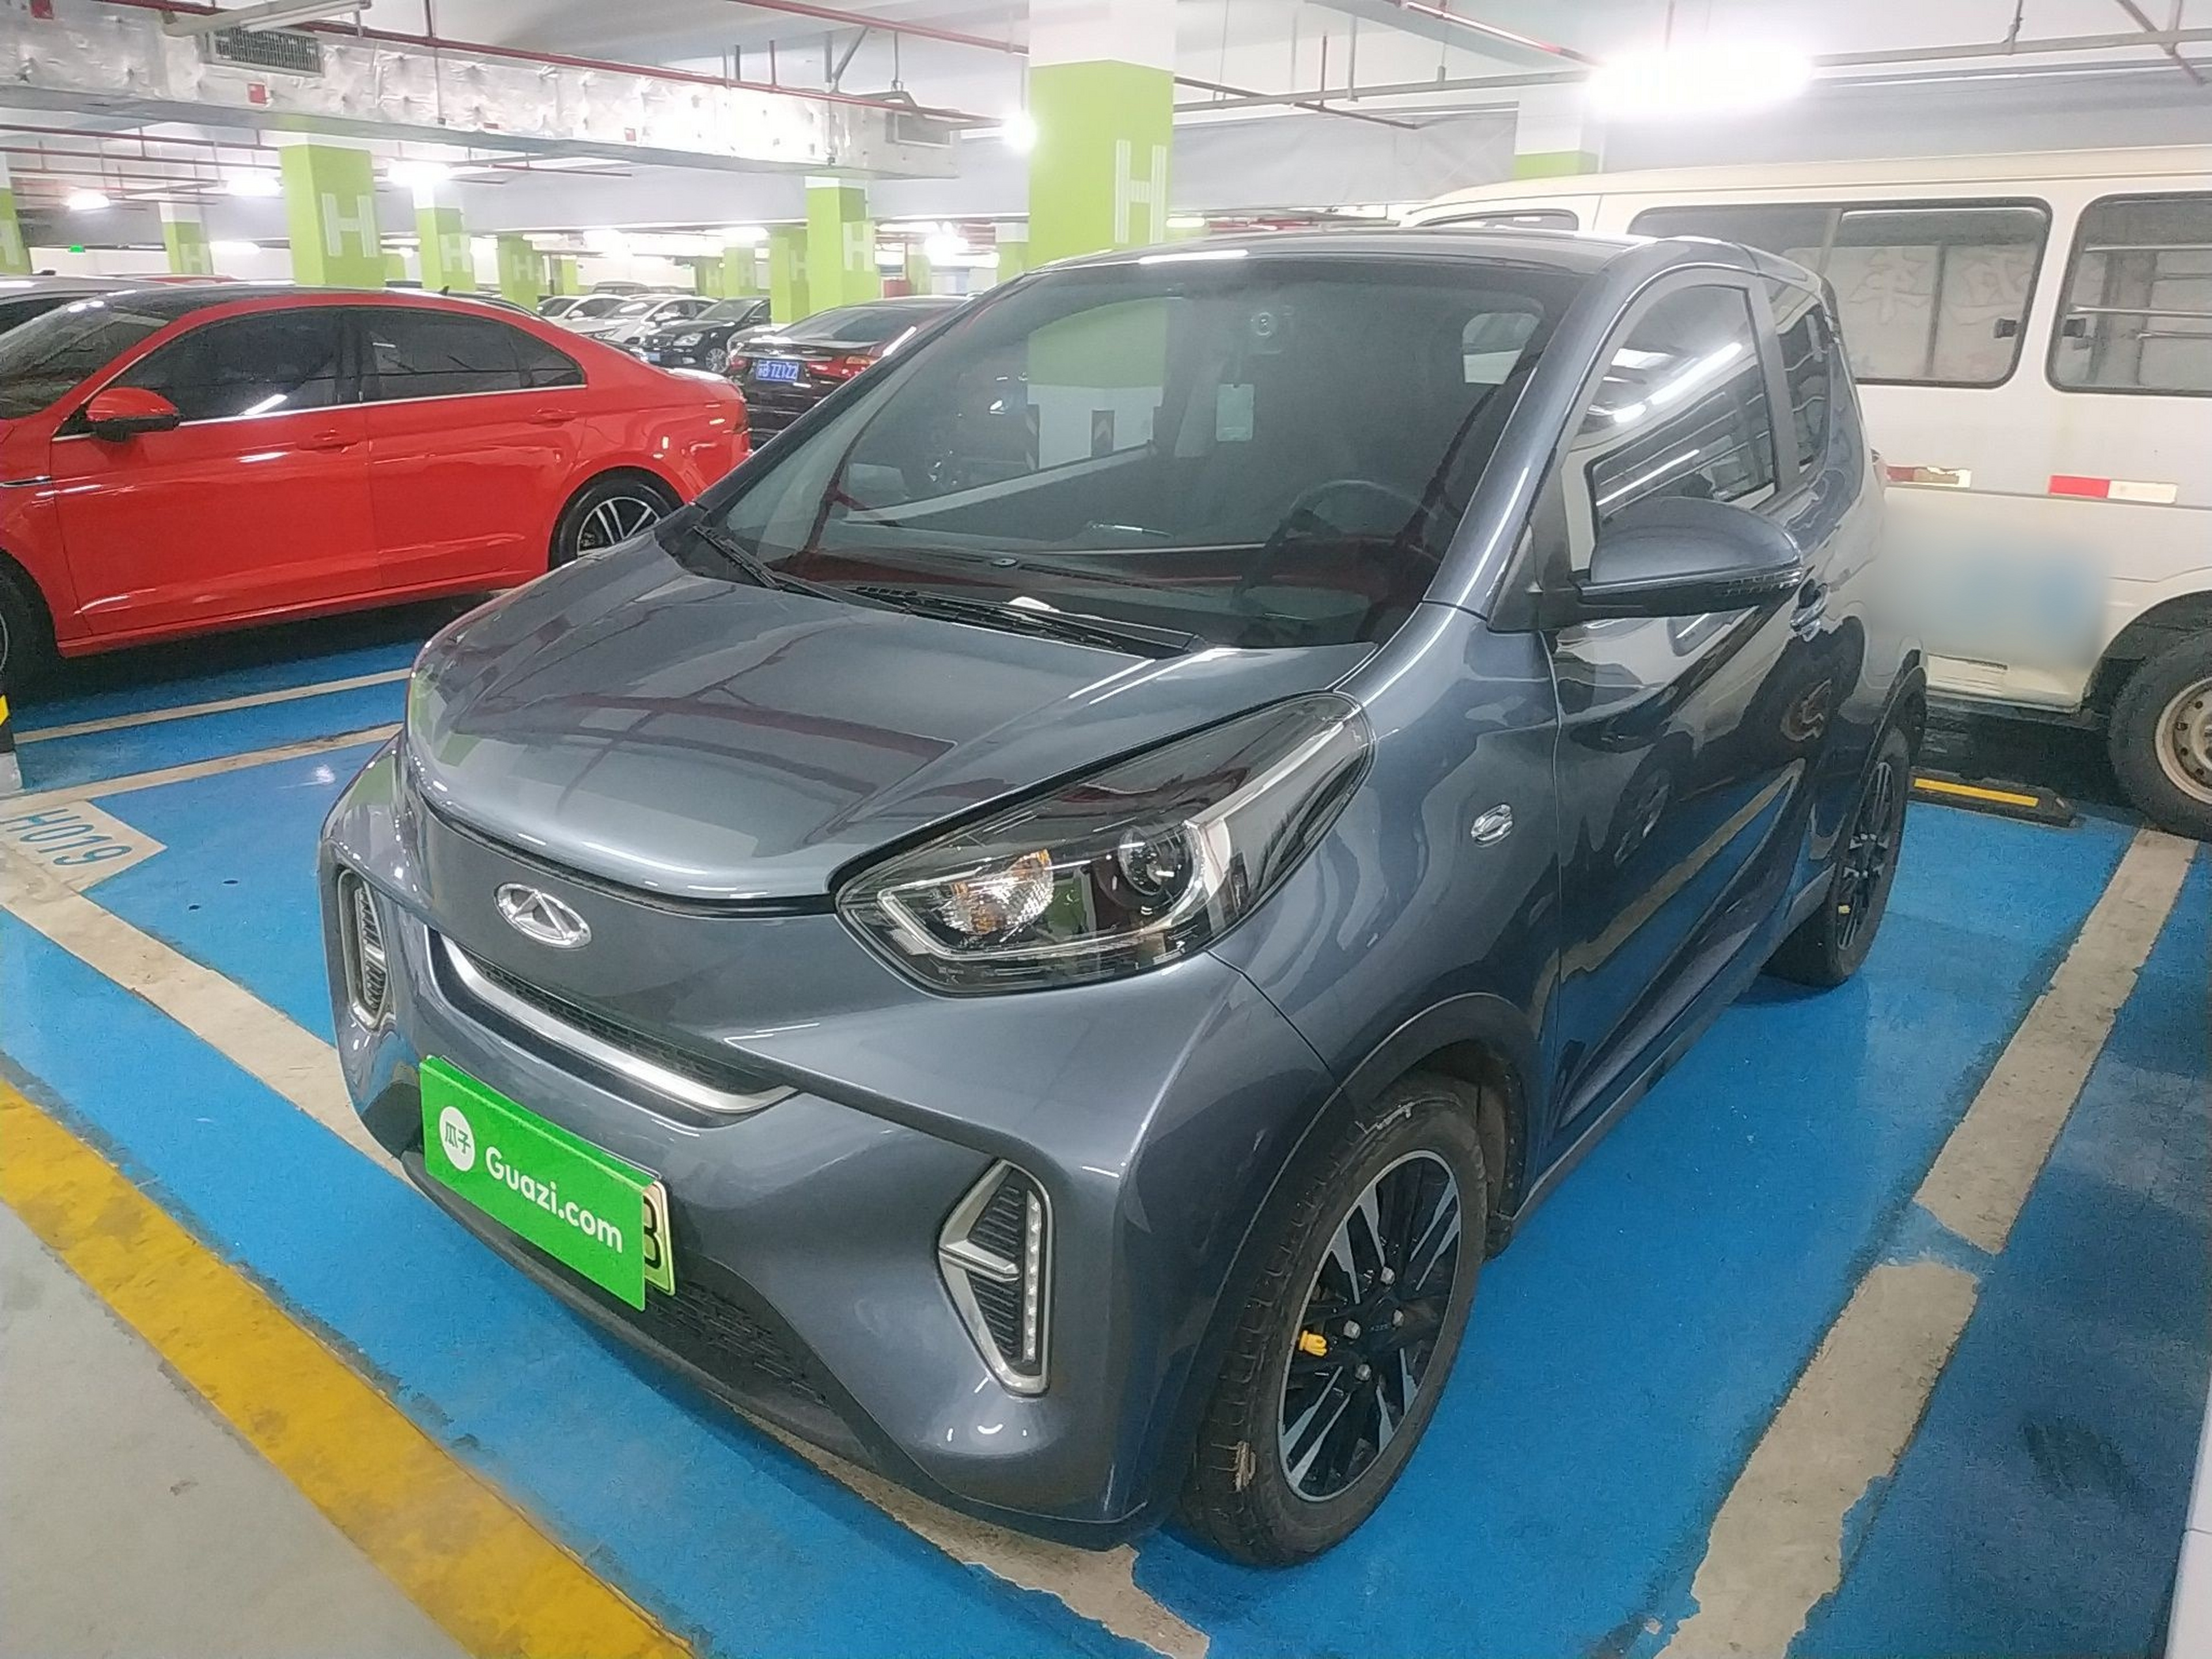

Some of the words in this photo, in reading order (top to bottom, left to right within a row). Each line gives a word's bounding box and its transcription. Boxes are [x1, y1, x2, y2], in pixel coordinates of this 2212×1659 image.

[1115, 139, 1166, 244] H
[321, 193, 377, 257] H
[843, 221, 874, 271] H
[439, 233, 472, 272] H
[512, 255, 534, 281] H
[0, 809, 132, 866] H019
[445, 1122, 472, 1154] 瓜子
[485, 1146, 623, 1254] Guazi.com
